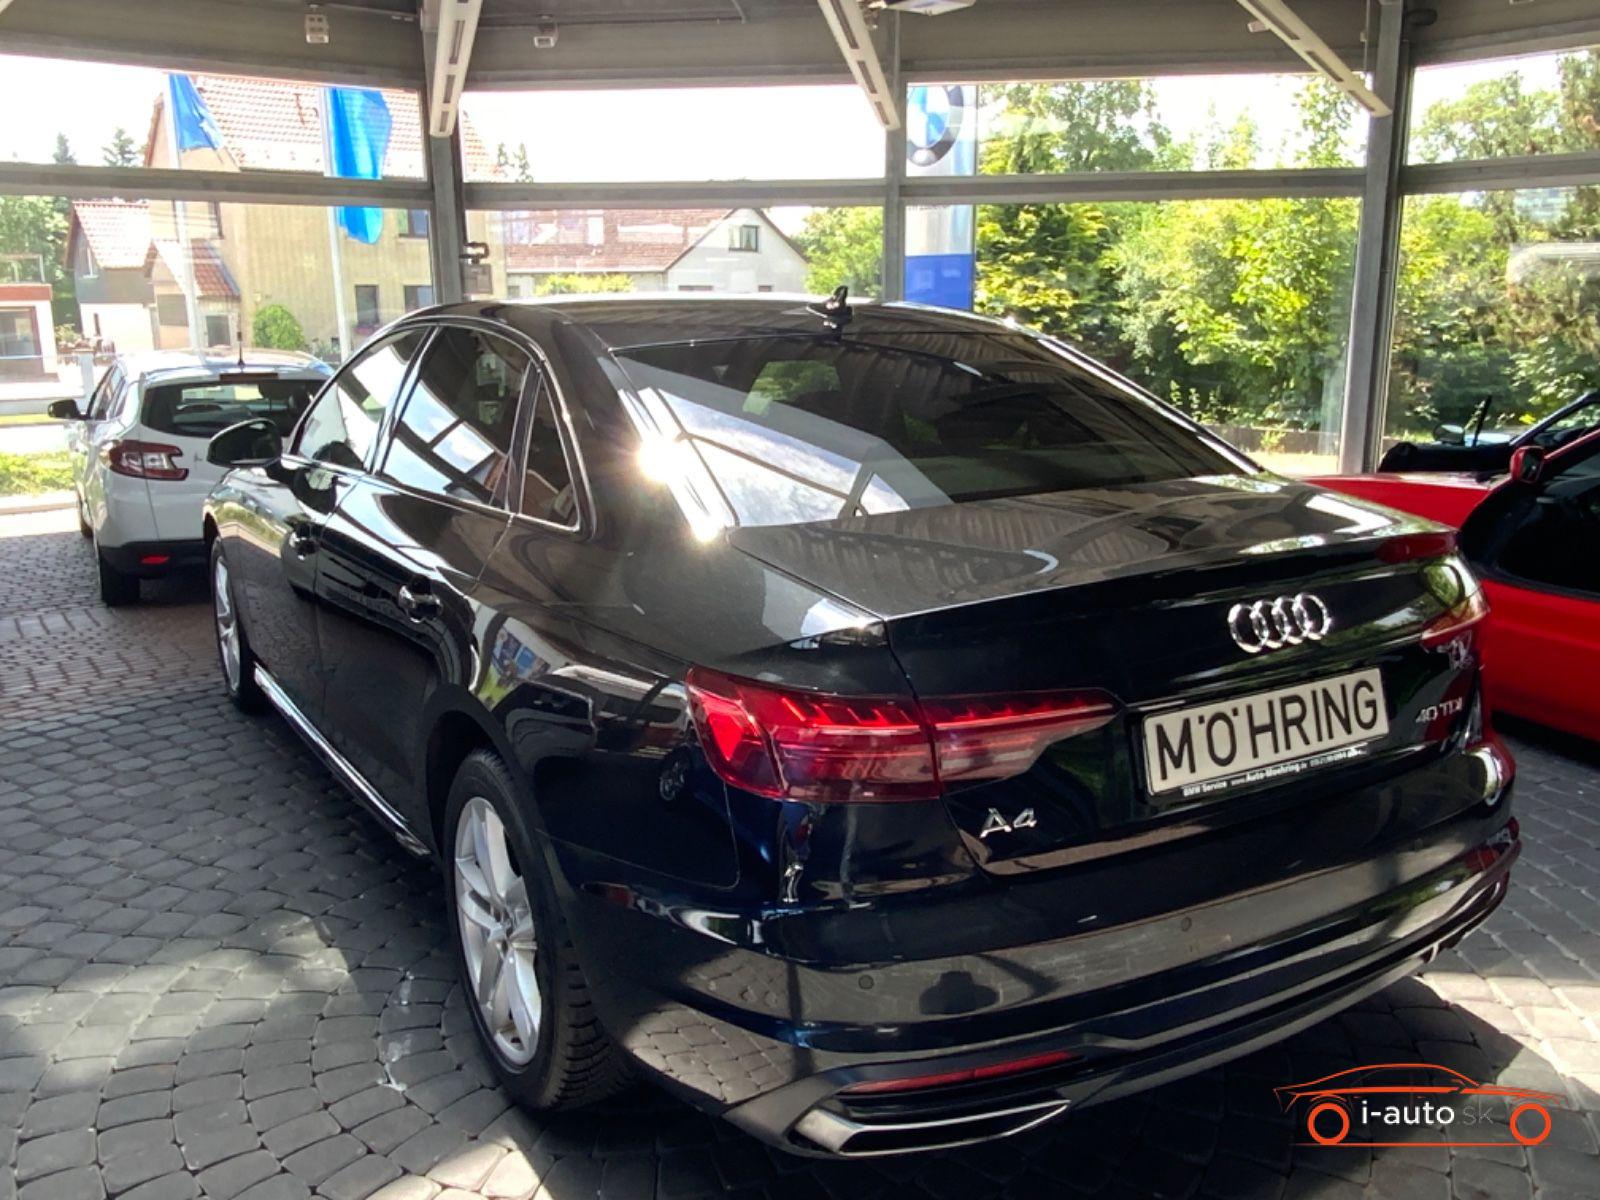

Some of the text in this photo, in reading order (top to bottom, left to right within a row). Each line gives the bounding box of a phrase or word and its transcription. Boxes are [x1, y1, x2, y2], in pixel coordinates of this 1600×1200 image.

[1415, 697, 1463, 723] 40 TDI
[1155, 680, 1378, 781] MÖHRING
[979, 807, 1037, 838] A4
